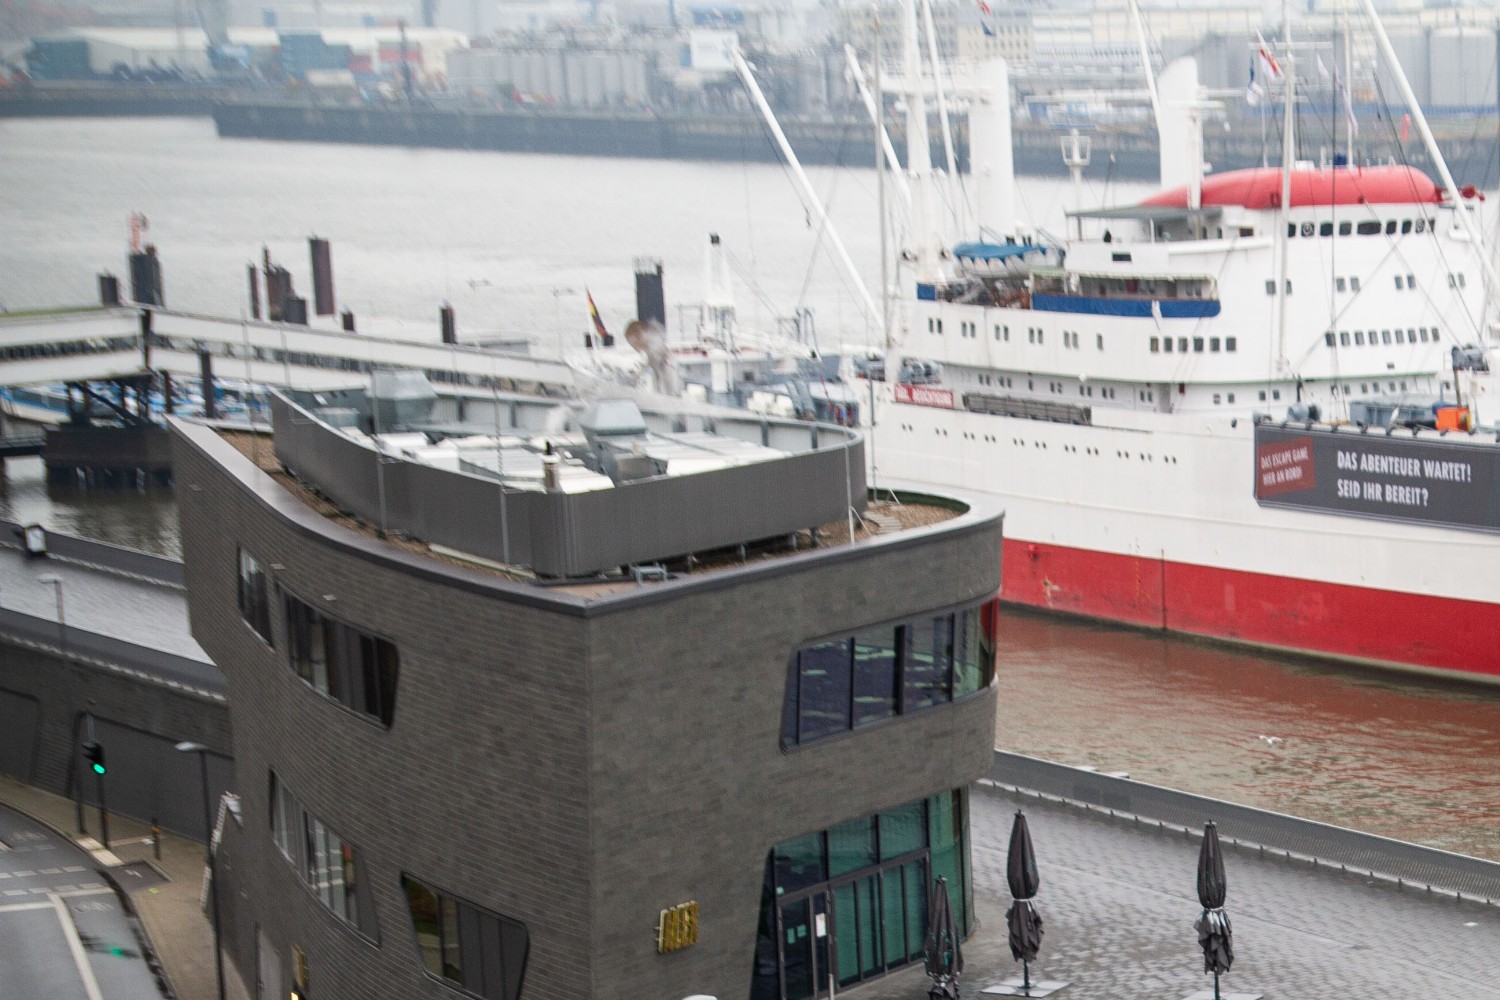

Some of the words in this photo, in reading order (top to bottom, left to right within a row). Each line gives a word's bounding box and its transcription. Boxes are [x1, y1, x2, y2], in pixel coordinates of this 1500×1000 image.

[1337, 450, 1359, 471] DAS
[1360, 453, 1421, 478] ABENTEUER
[1423, 459, 1472, 483] WARTET!
[1337, 478, 1361, 499] SEID
[1363, 481, 1383, 501] IHR
[1385, 483, 1429, 507] BEREIT?
